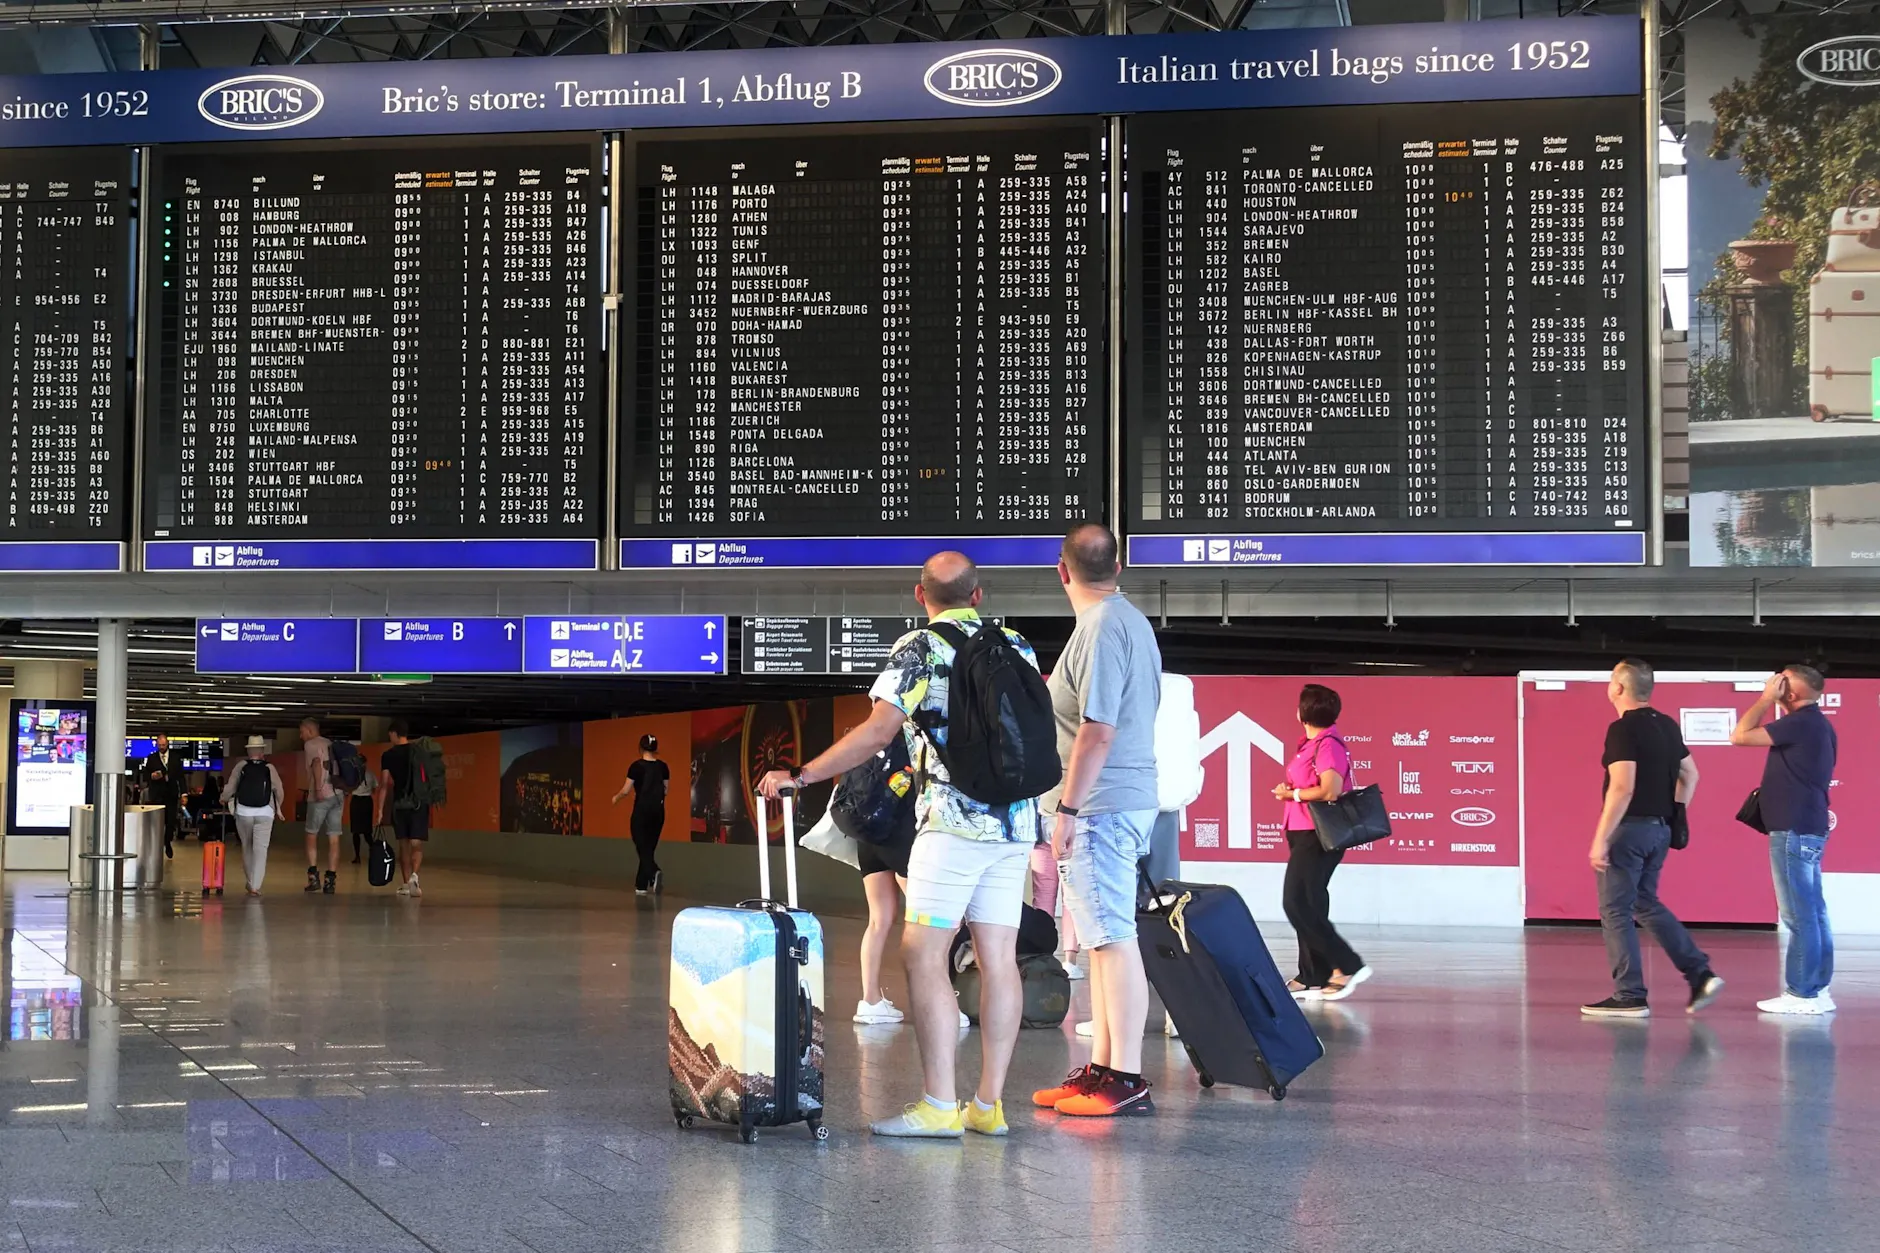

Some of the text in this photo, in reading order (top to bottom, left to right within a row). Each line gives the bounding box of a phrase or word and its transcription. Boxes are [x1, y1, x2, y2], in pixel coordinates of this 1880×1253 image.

[1118, 40, 1590, 84] Italian travel bags since 1952
[948, 62, 1038, 90] BRIC'S
[469, 90, 545, 111] store:
[555, 77, 686, 107] Terminal
[699, 77, 723, 108] 1,
[732, 73, 831, 108] Abflug
[840, 71, 861, 98] B
[2, 90, 148, 120] since 1952
[220, 87, 302, 114] BRIC'S
[1472, 139, 1497, 147] Terminal
[662, 175, 1087, 197] LH 1148 MALAGA 259-335 A58
[1244, 180, 1373, 194] TORONTO-CANCELLED
[187, 190, 580, 210] EN 8740 BILLUND 259-335 B4
[732, 198, 767, 209] PORTO
[1244, 196, 1296, 208] HOUSTON
[37, 216, 114, 227] 744-747 B48
[253, 211, 299, 221] HAMBURG
[732, 212, 767, 222] ATHEN
[253, 222, 353, 234] LONDON-HEATHROW
[1244, 224, 1304, 236] SARAJEVO
[732, 239, 759, 249] GENF
[254, 250, 305, 261] ISTANBUL
[1244, 253, 1281, 264] KAIRO
[732, 265, 788, 276] HANNOVER
[732, 278, 809, 290] DUESSELDORF
[1244, 281, 1289, 292] ZAGREB
[35, 294, 106, 305] 954-956 E2
[732, 291, 831, 303] MADRID-BARAJAS
[252, 303, 304, 313] BUDAPEST
[732, 304, 868, 317] NUERNBERF-WUERZBURG
[732, 319, 802, 331] DOHA-HAMAD
[251, 342, 344, 353] MAILAND-LINATE
[1244, 350, 1381, 362] KOPENHAGEN-KASTRUP
[1244, 365, 1304, 377] CHISINAU
[250, 382, 303, 392] LISSABON
[731, 387, 859, 399] BERLIN-BRANDENBURG
[250, 408, 309, 419] CHARLOTTE
[1244, 406, 1390, 419] VANCOUVER-CANCELLED
[250, 422, 309, 432] LUXEMBURG
[249, 448, 275, 458] WIEN
[1244, 450, 1297, 461] ATLANTA
[730, 483, 859, 494] MONTREAL-CANCELLED
[1168, 490, 1627, 504] XQ 3141 BODRUM 740-742 B43
[30, 503, 108, 514] 489-498 Z20
[248, 501, 299, 512] HELSINKI
[1245, 506, 1376, 517] STOCKHOLM-ARLANDA
[247, 515, 308, 525] AMSTERDAM
[730, 511, 765, 522] SOFIA
[719, 543, 746, 554] Abflug
[1233, 539, 1263, 551] Abflug
[236, 546, 263, 557] Abflug
[1233, 552, 1282, 562] Departures
[237, 557, 279, 567] Departures
[719, 555, 764, 565] Departures
[241, 623, 265, 632] Abflug
[283, 622, 295, 641] C
[405, 622, 429, 632] Abflug
[453, 622, 464, 641] B
[571, 622, 600, 632] Terminal
[241, 632, 280, 642] Departures
[405, 632, 444, 642] Departures
[570, 649, 594, 660] Abflug
[570, 659, 608, 669] Departures
[1449, 736, 1495, 744] Samsonite
[1451, 761, 1494, 773] TUMI
[1403, 772, 1420, 783] GOT
